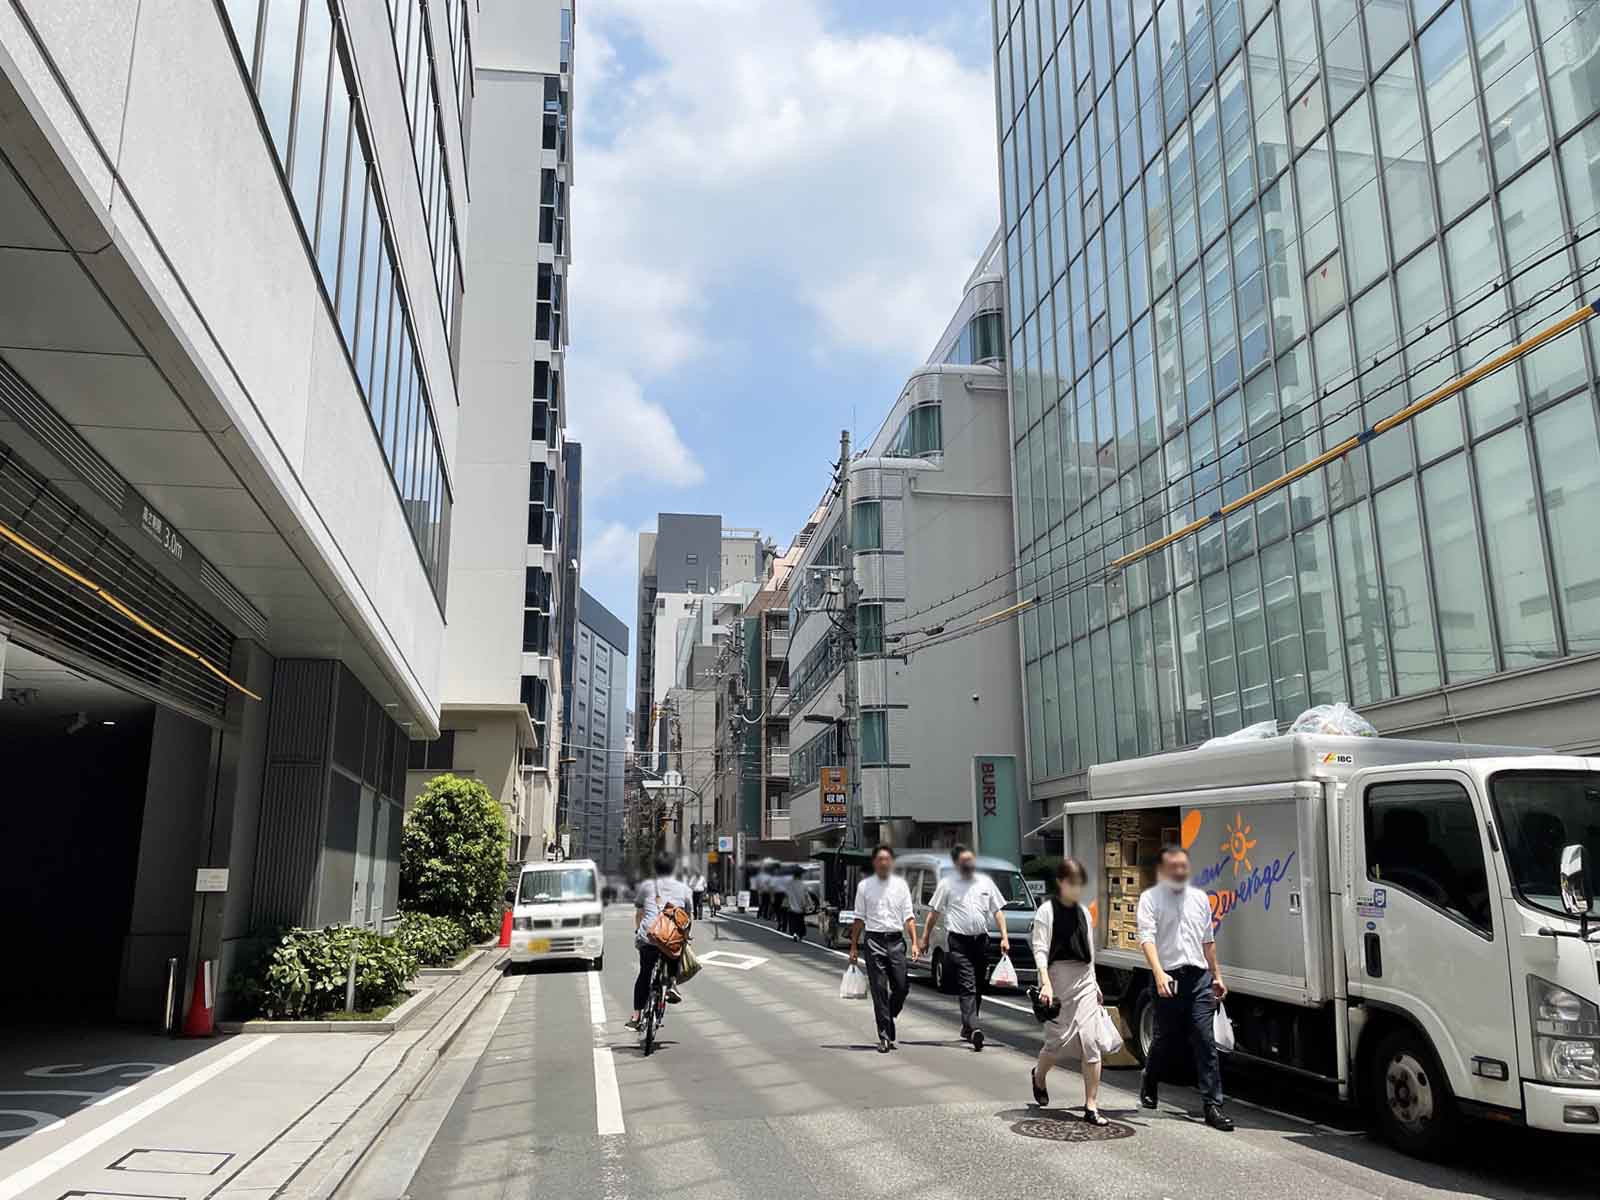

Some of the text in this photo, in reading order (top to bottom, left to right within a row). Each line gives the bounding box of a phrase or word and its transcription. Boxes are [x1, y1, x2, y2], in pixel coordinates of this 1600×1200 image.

[164, 527, 182, 560] 3.0m
[1337, 755, 1352, 763] IBC
[982, 762, 997, 817] BUREX
[1207, 851, 1295, 937] Beverage
